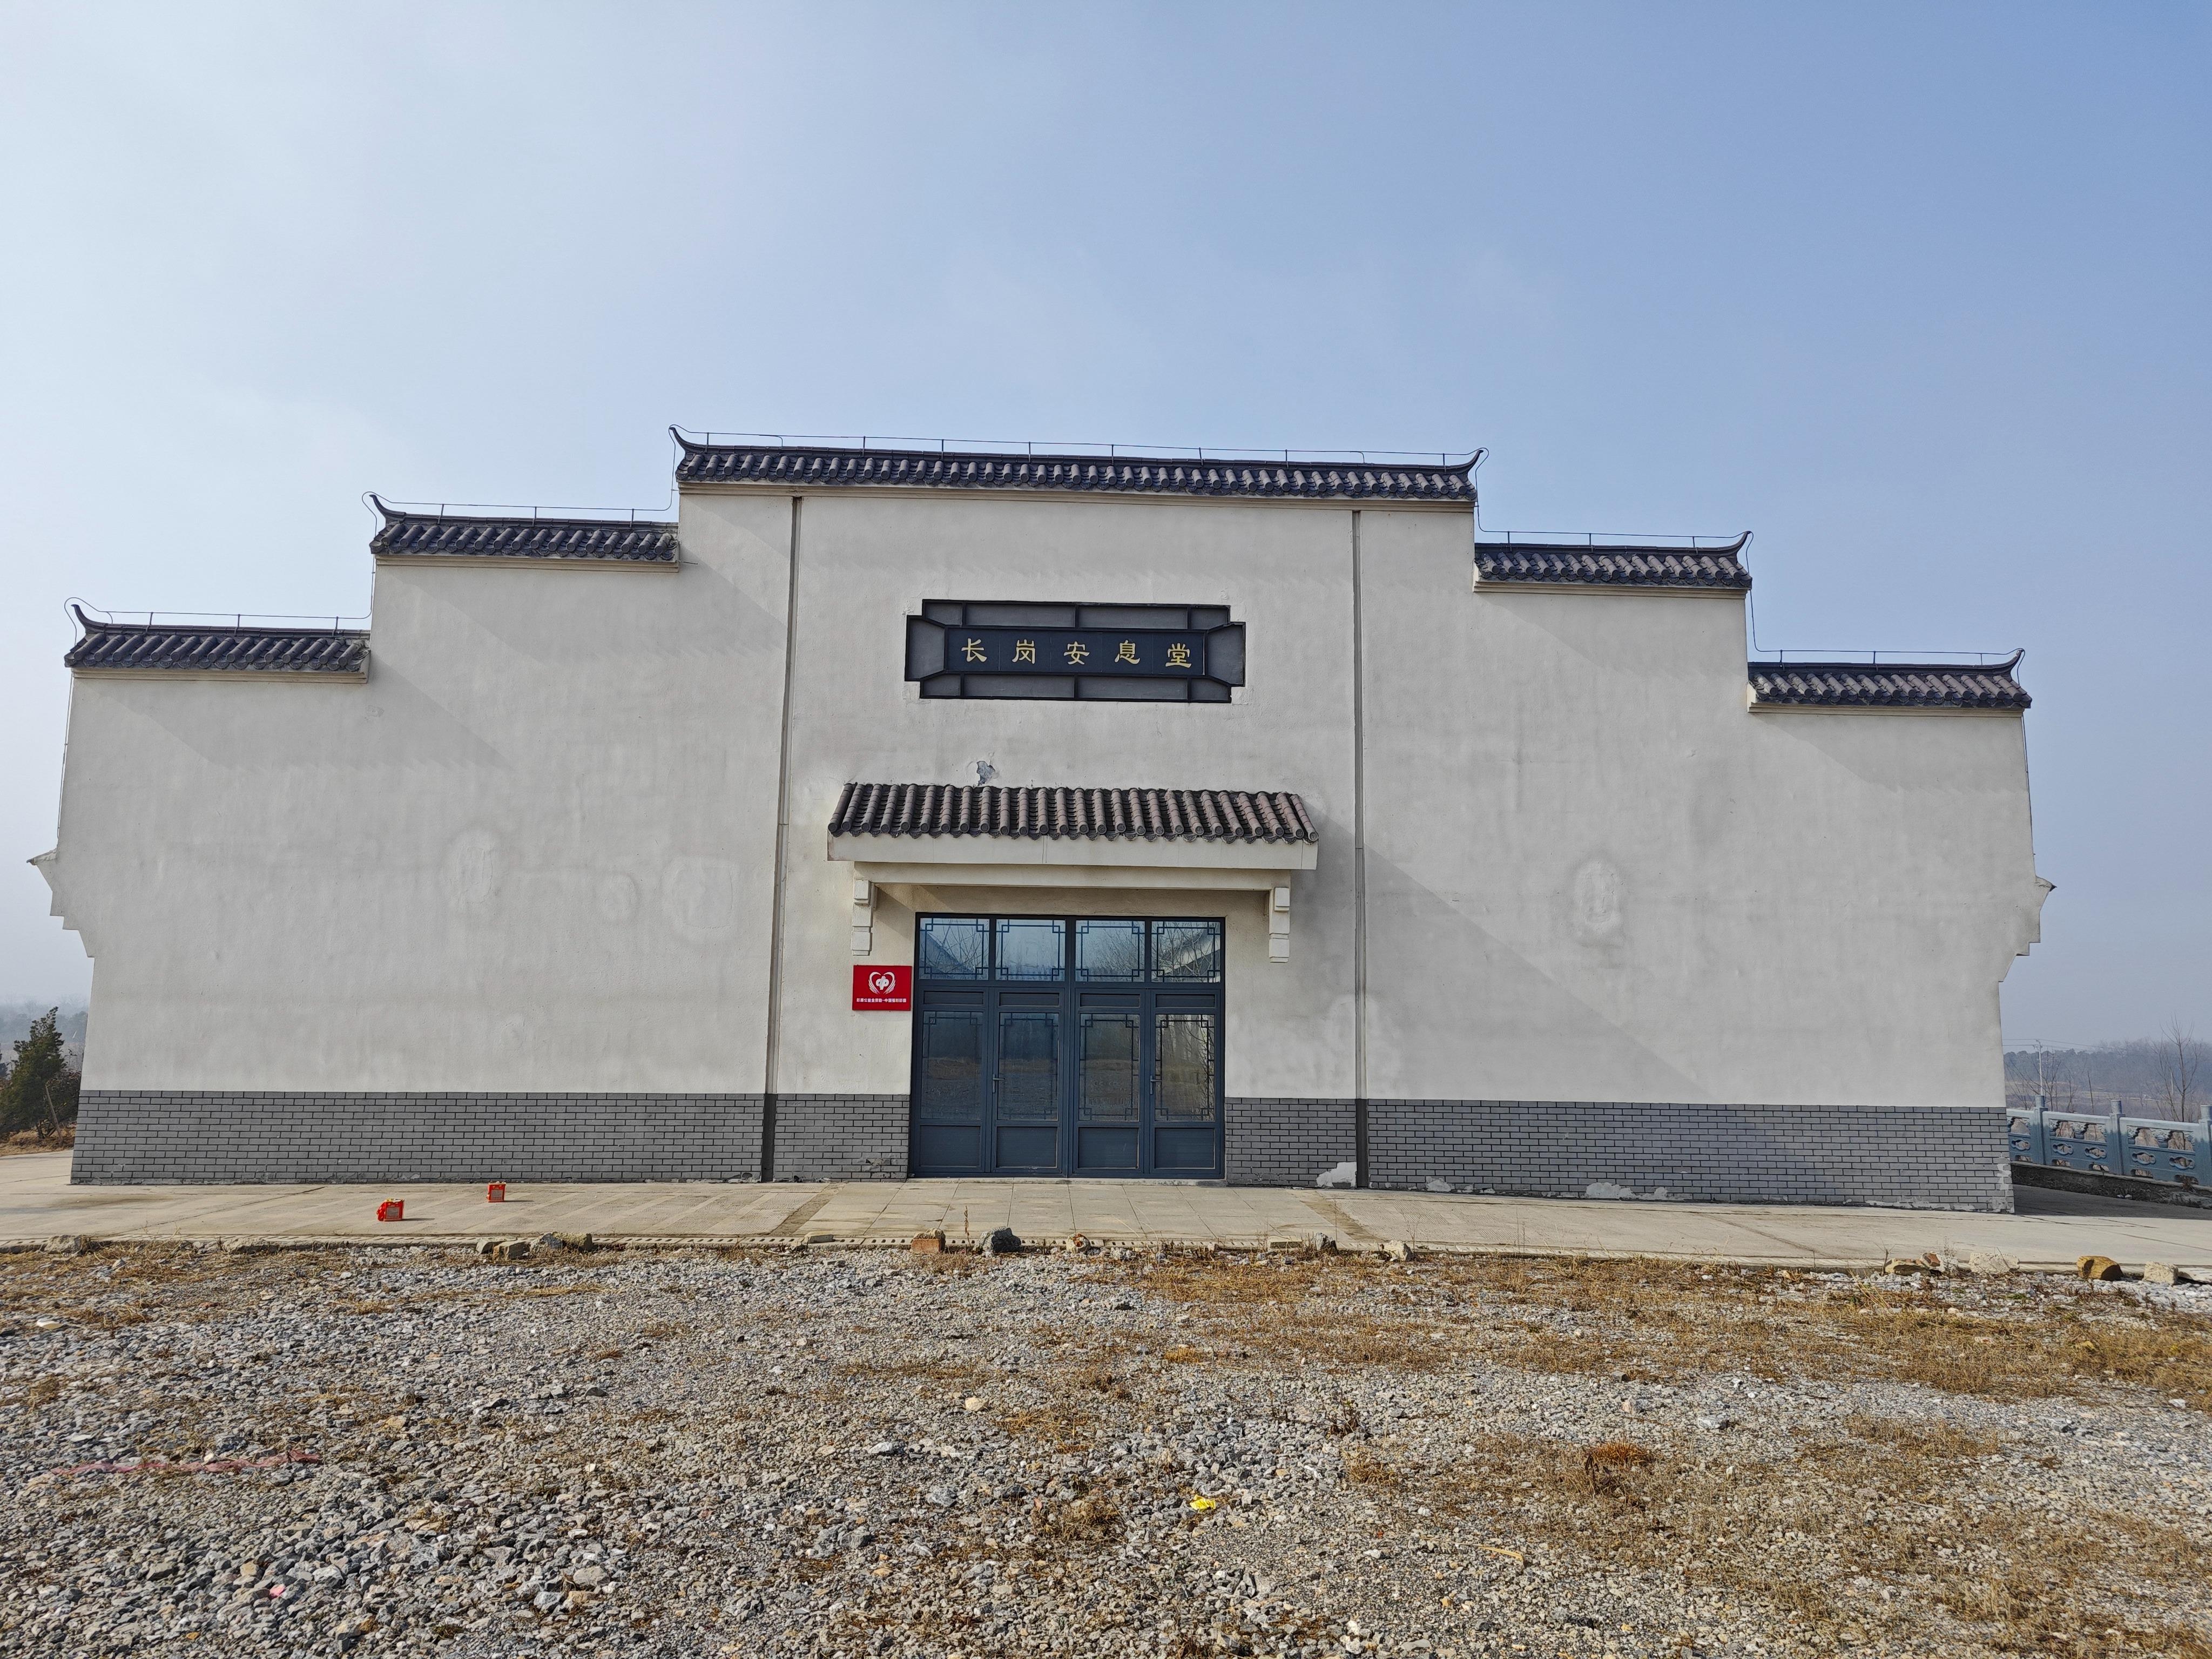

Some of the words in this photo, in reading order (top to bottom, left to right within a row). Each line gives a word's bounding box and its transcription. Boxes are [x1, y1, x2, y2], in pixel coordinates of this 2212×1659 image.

[961, 638, 1191, 668] 长岗安息堂
